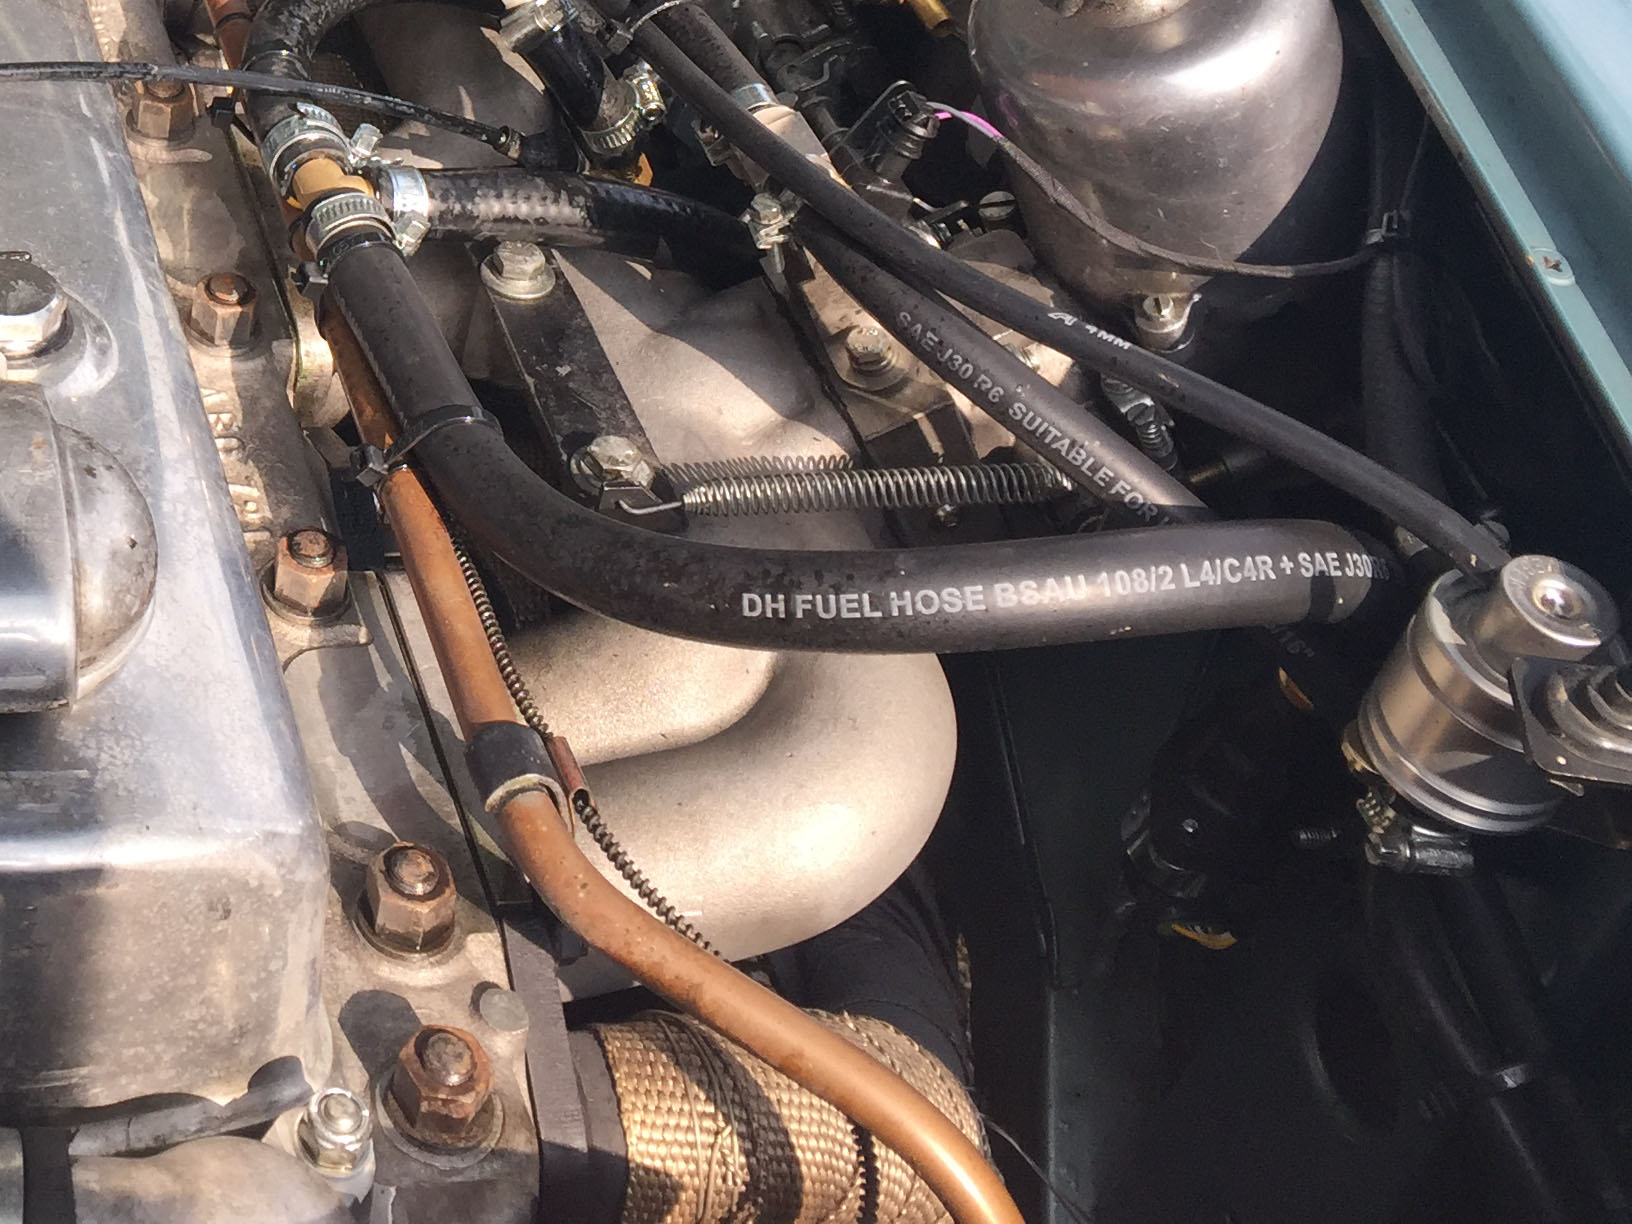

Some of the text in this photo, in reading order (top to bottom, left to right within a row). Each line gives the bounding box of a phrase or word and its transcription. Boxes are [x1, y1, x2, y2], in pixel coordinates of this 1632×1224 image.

[896, 311, 1159, 522] SAE J30 R6 SUITABLE FOR
[741, 593, 785, 618] DH
[795, 593, 883, 619] FUEL
[890, 585, 987, 617] HOSE
[992, 574, 1088, 608] BSAU
[1097, 565, 1176, 598] 108/2
[1180, 554, 1276, 588] L4/C4R
[1297, 552, 1342, 577] SAE
[1345, 552, 1373, 578] J30
